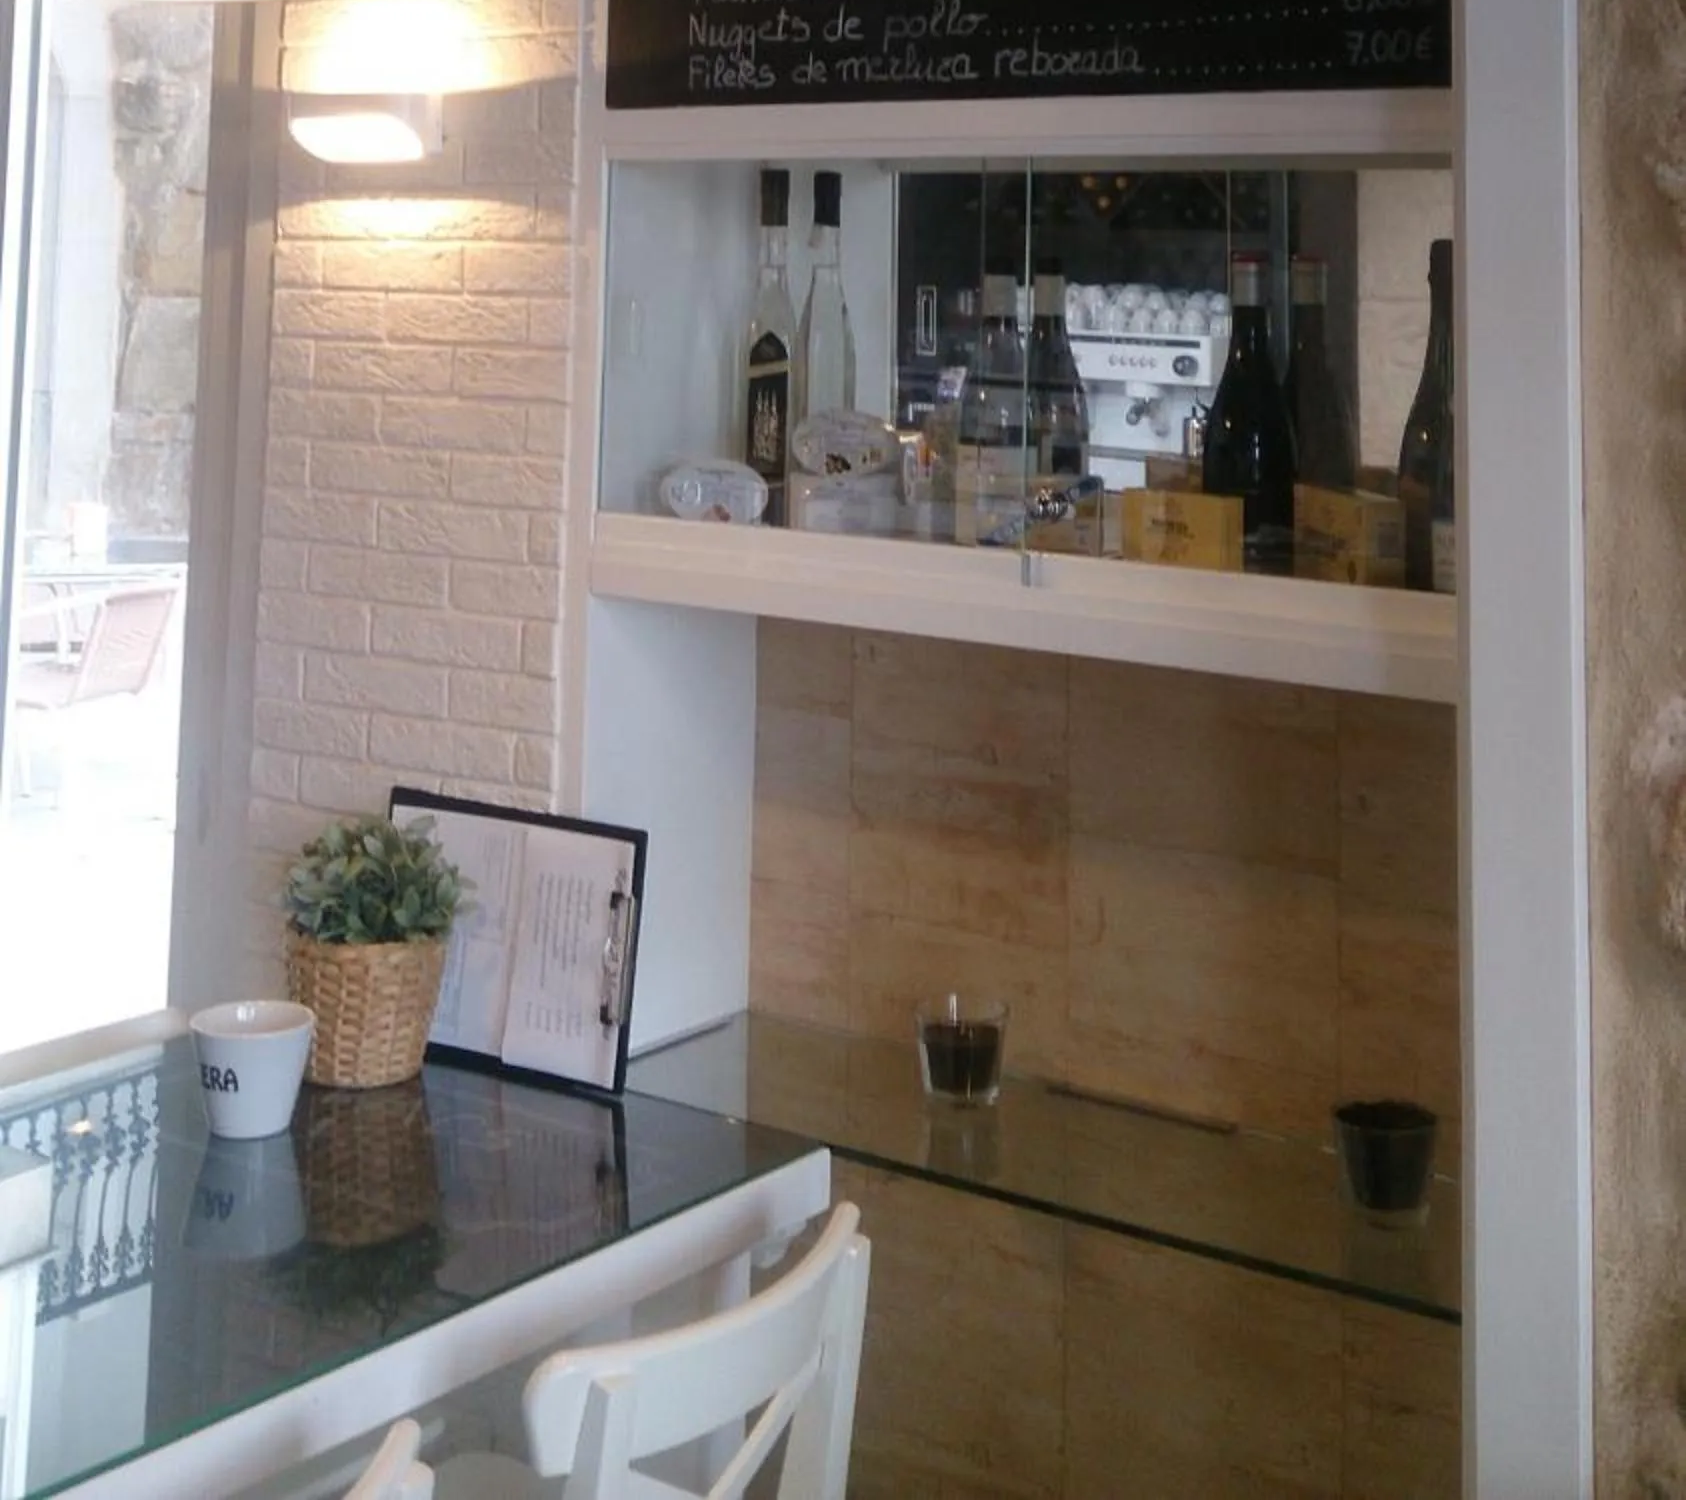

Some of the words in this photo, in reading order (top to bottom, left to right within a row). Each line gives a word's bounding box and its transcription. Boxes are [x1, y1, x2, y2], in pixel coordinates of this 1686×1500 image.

[688, 5, 812, 62] Nuggets
[822, 3, 864, 43] de
[687, 52, 777, 92] Filetes
[790, 50, 828, 85] de
[835, 41, 981, 83] merluza
[993, 33, 1147, 79] rebozada
